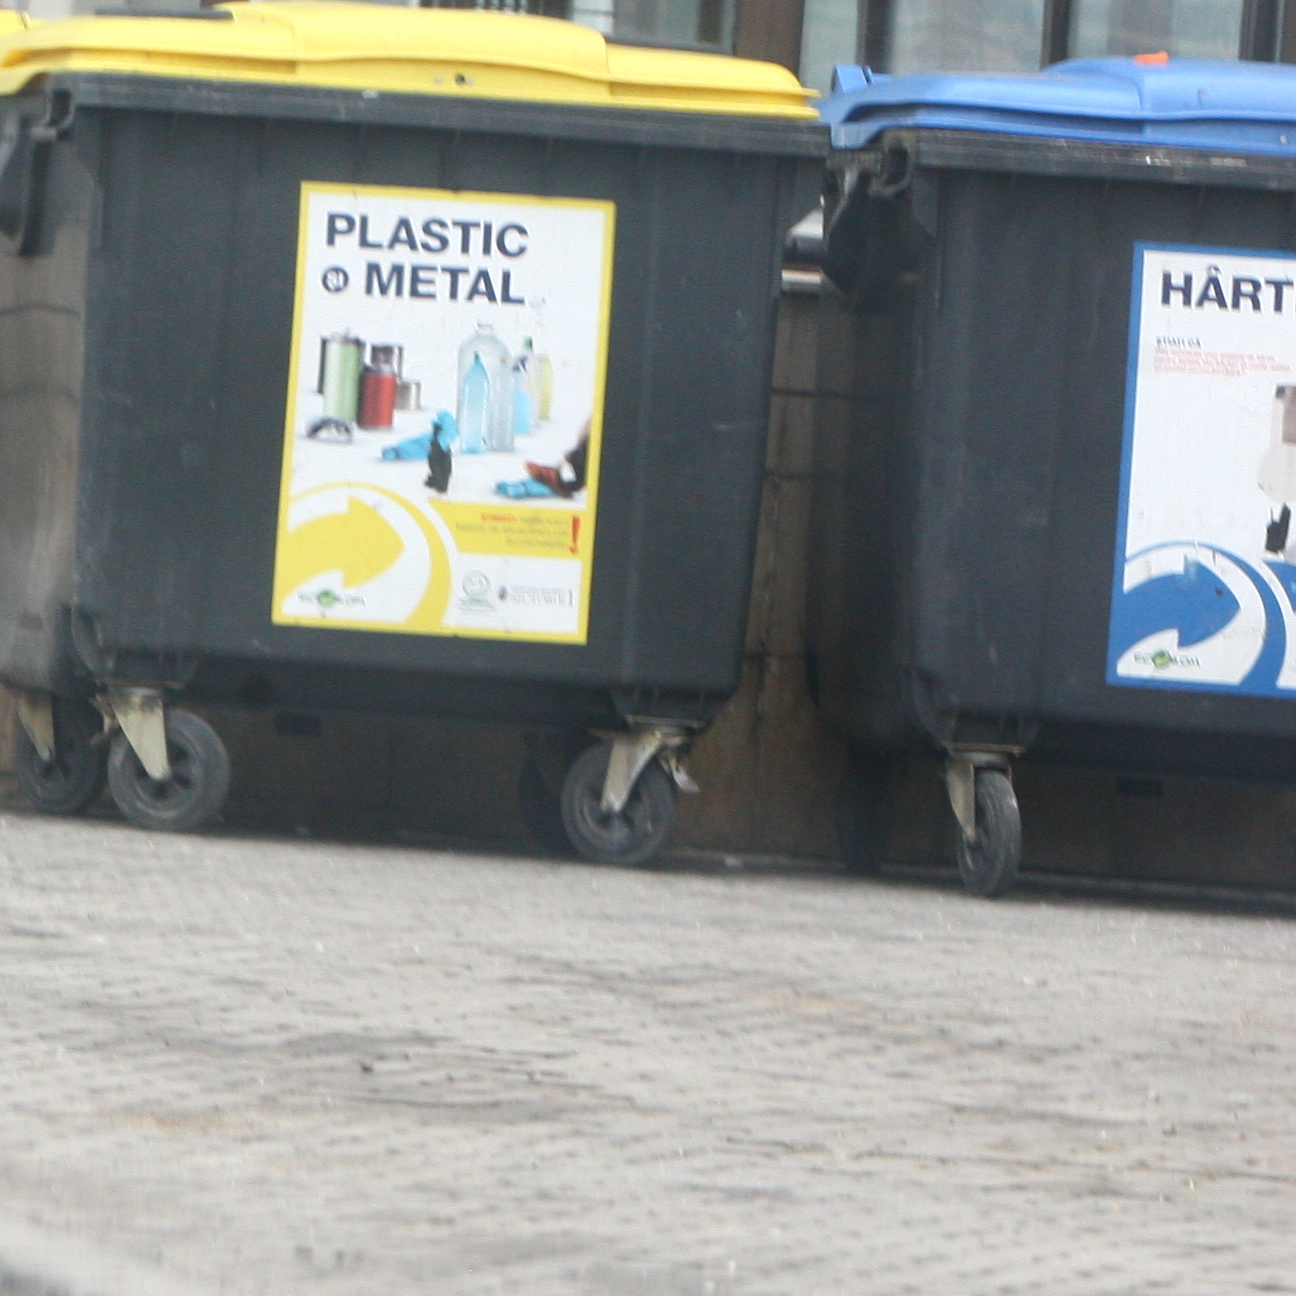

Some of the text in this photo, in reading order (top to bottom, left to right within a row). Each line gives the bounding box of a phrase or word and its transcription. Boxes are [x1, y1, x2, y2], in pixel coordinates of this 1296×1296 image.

[325, 211, 530, 259] PLASTIC
[364, 260, 526, 305] METAL
[1160, 262, 1296, 315] HÂRT
